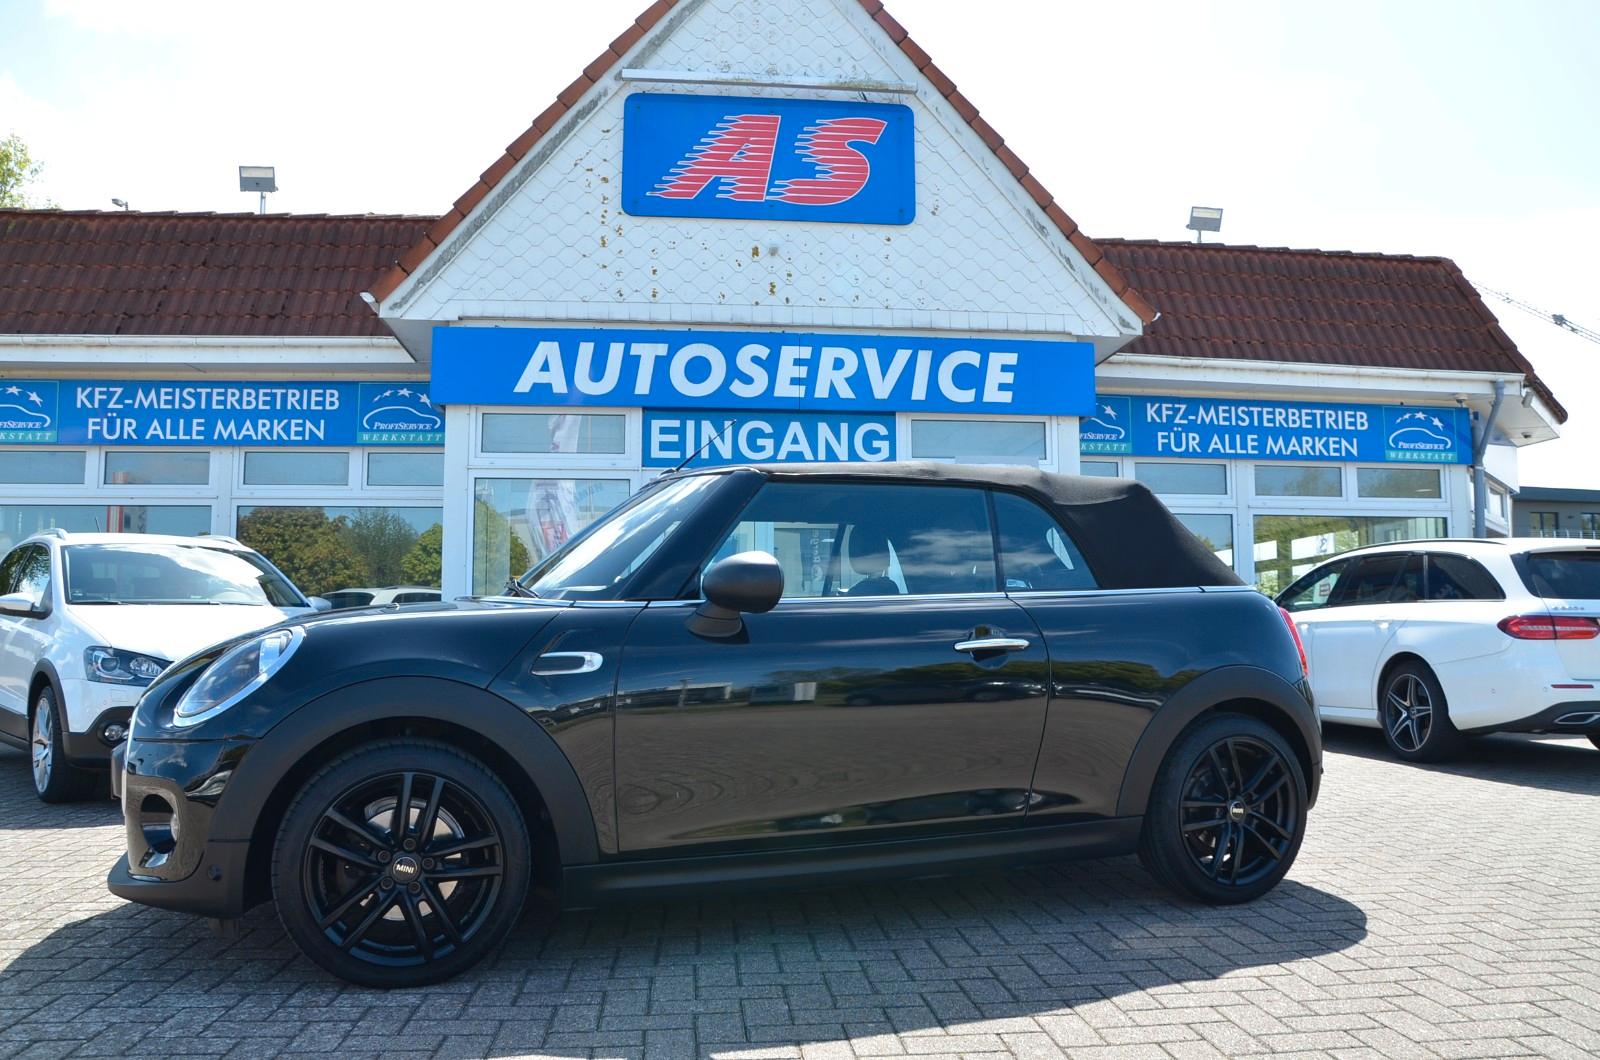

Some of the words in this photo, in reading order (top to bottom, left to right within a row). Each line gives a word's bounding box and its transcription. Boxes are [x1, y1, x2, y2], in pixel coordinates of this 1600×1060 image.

[646, 114, 888, 206] AS
[513, 340, 1020, 404] AUTOSERVICE
[76, 387, 340, 410] KFZ-MEISTERBETRIEB
[87, 412, 138, 440] FÜR
[145, 418, 205, 440] ALLE
[213, 419, 325, 441] MARKEN
[1146, 403, 1369, 431] KFZ-MEISTERBETRIEB
[362, 433, 442, 441] WERKSTATT
[650, 418, 891, 463] EINGANG
[1157, 427, 1202, 453] FÜR
[1207, 434, 1259, 455] ALLE
[1265, 435, 1358, 457] MARKEN
[395, 863, 415, 874] MINI
